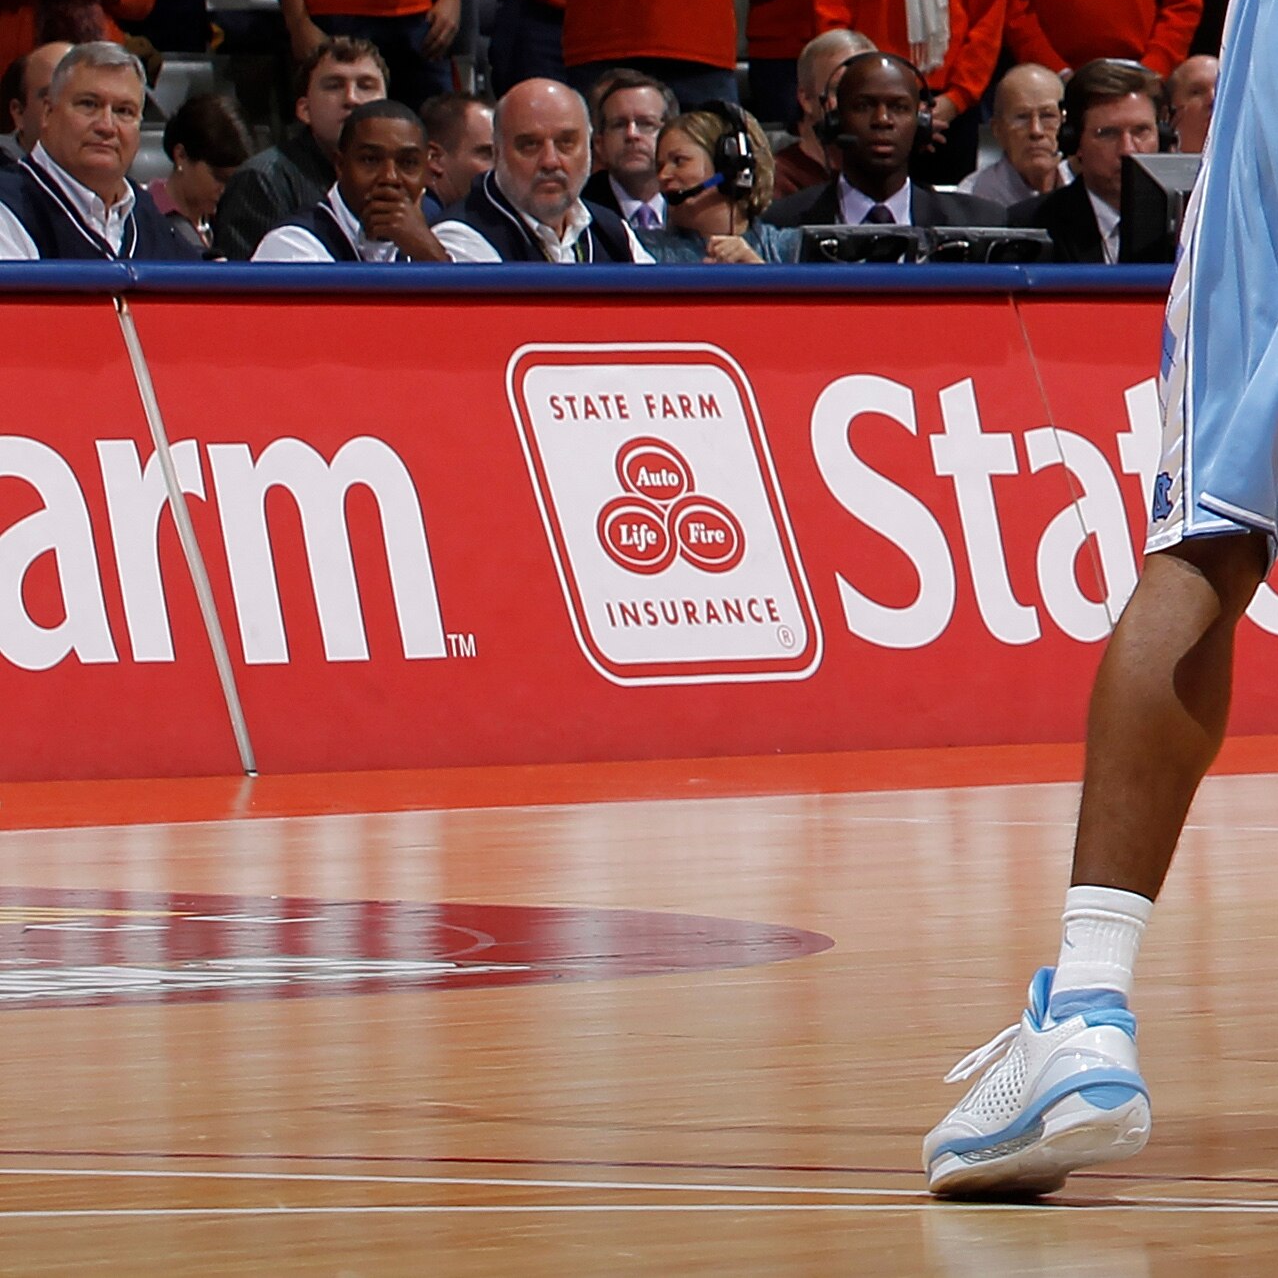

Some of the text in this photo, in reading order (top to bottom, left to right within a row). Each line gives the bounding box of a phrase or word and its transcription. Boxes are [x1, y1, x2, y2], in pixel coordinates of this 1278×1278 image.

[549, 393, 723, 420] STATE FARM
[635, 465, 680, 488] Auto
[619, 522, 726, 552] Life Fire
[606, 597, 781, 627] INSURANCE
